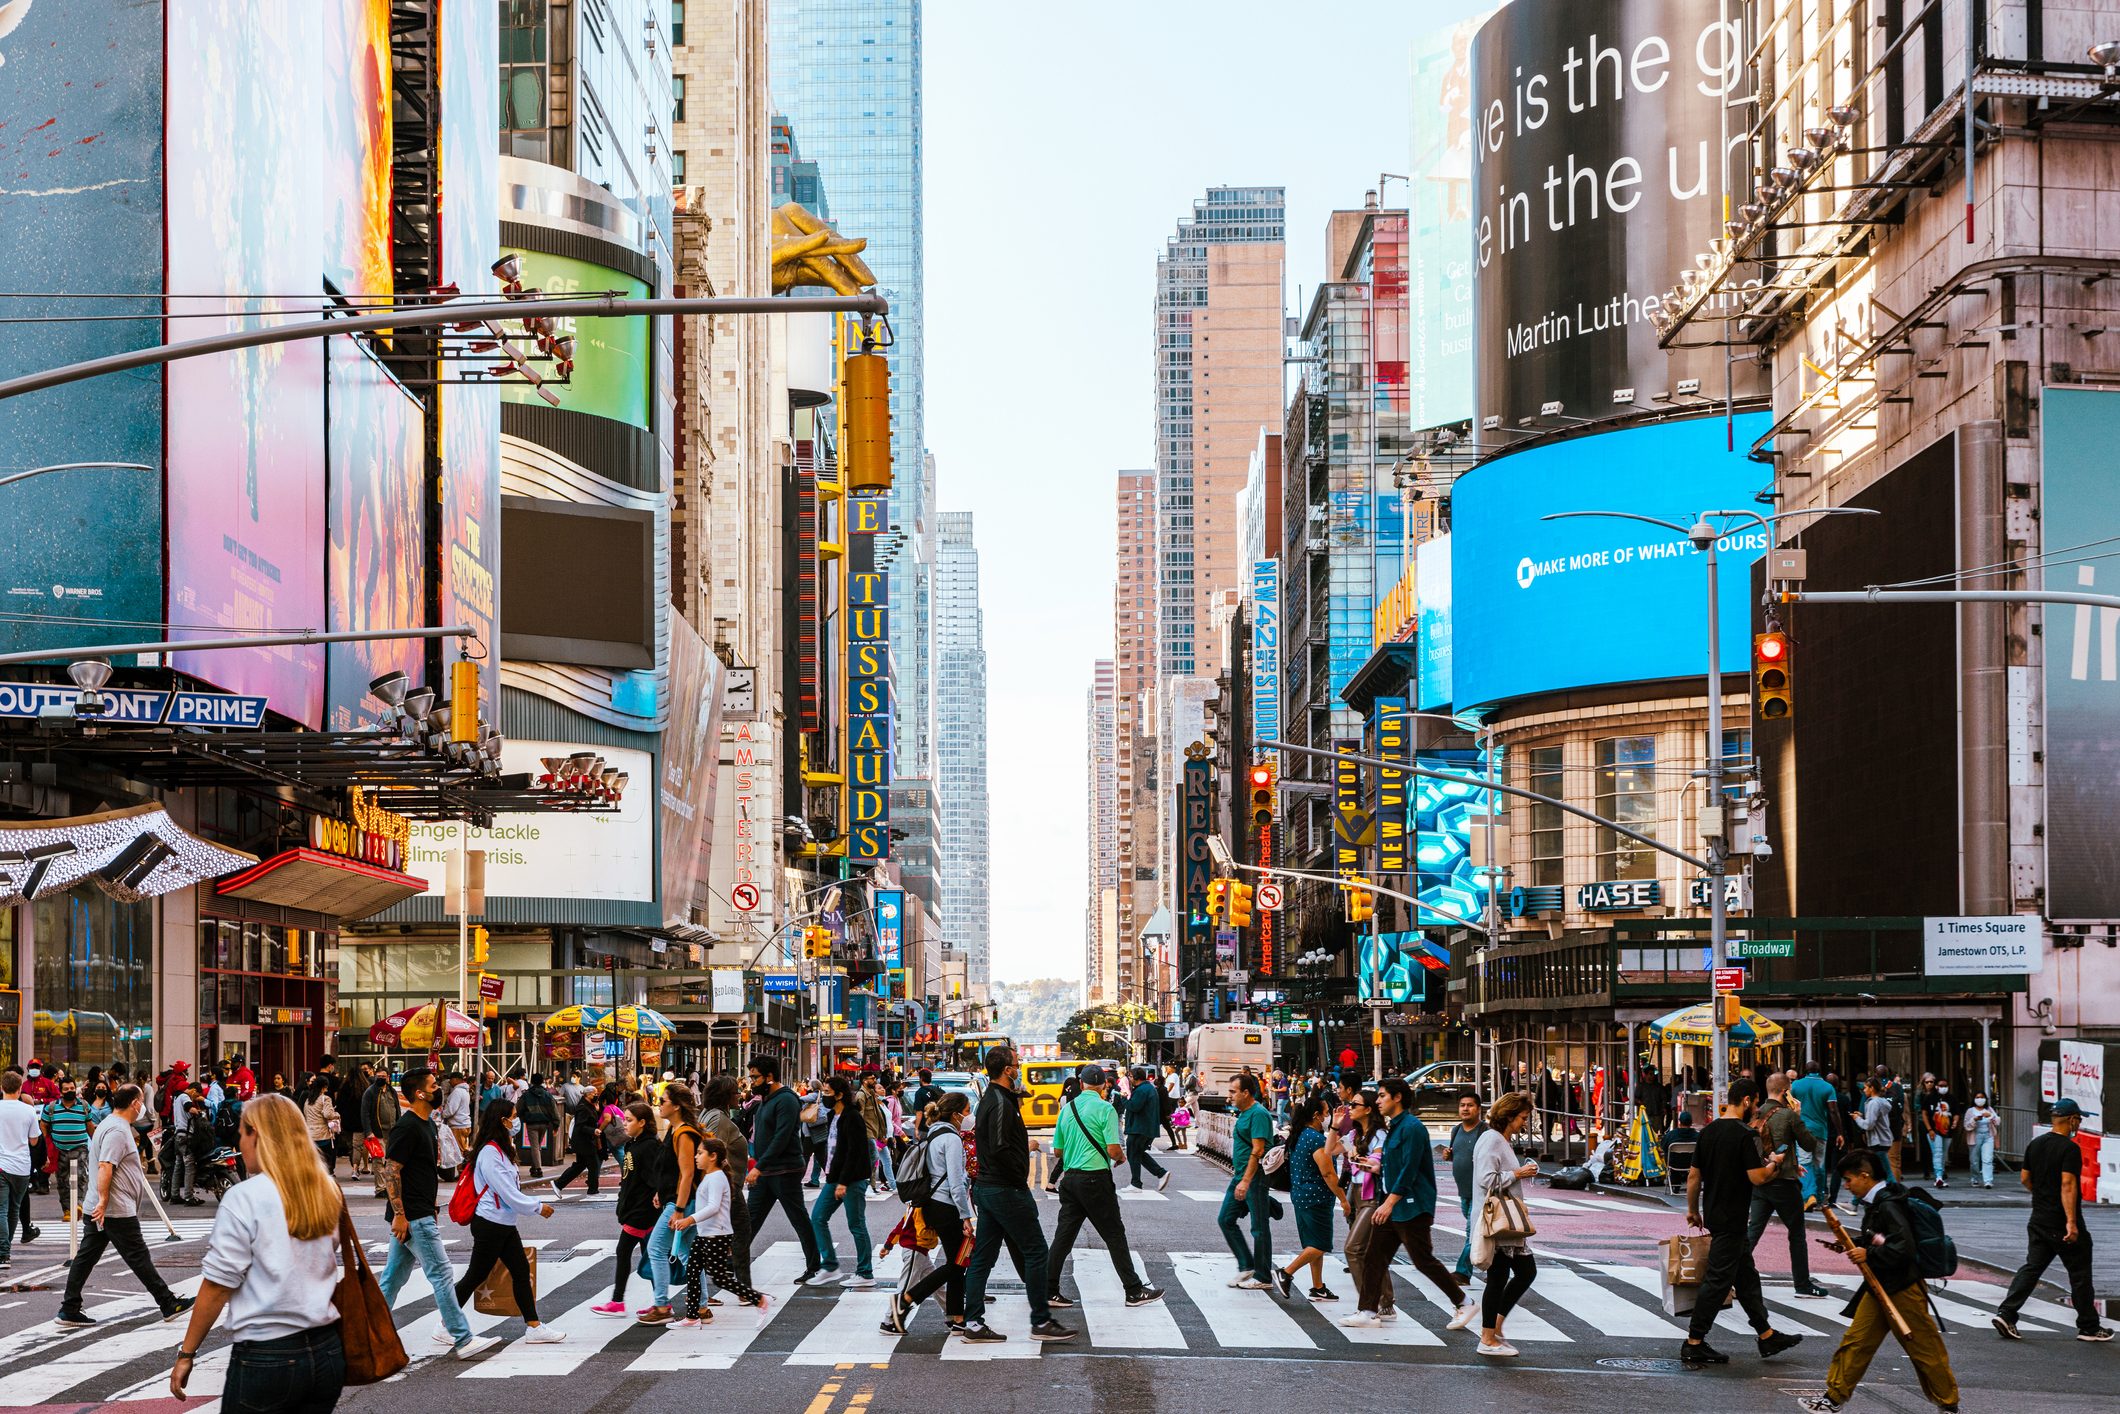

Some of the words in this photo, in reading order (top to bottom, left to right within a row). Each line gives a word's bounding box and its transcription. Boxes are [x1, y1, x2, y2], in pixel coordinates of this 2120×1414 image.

[1515, 66, 1549, 137] is
[1562, 34, 1670, 114] the
[1500, 184, 1530, 254] in
[1543, 154, 1643, 232] the
[1507, 311, 1570, 359] Martin
[1578, 292, 1669, 335] Luther
[1534, 557, 1566, 577] MAKE
[1569, 554, 1609, 571] MORE
[1613, 547, 1634, 564] OF
[1716, 533, 1767, 553] OURS
[1254, 561, 1276, 603] NEW
[0, 687, 160, 719] OUTFONT
[179, 698, 257, 723] PRIME
[853, 573, 883, 859] TUSSAUD'S
[1381, 704, 1401, 807] VICTORY
[1338, 745, 1357, 811] CTORY
[410, 823, 458, 842] enge
[488, 823, 540, 840] tackle
[735, 722, 756, 934] AMSTERDM
[1186, 768, 1210, 926] REGAL
[1382, 821, 1402, 869] NEW
[406, 845, 448, 863] lima
[483, 847, 527, 865] risis.
[1577, 882, 1652, 909] CHASE
[1938, 923, 1945, 934] 1
[1948, 922, 1983, 934] Times
[1985, 921, 2026, 935] Square
[1742, 942, 1791, 958] Broadway
[1938, 946, 1988, 957] Jamestown
[1990, 945, 2010, 957] OTS,
[2012, 945, 2026, 956] L.P.
[453, 1033, 477, 1045] Coca-Cola
[1665, 1032, 1713, 1043] SABRETT
